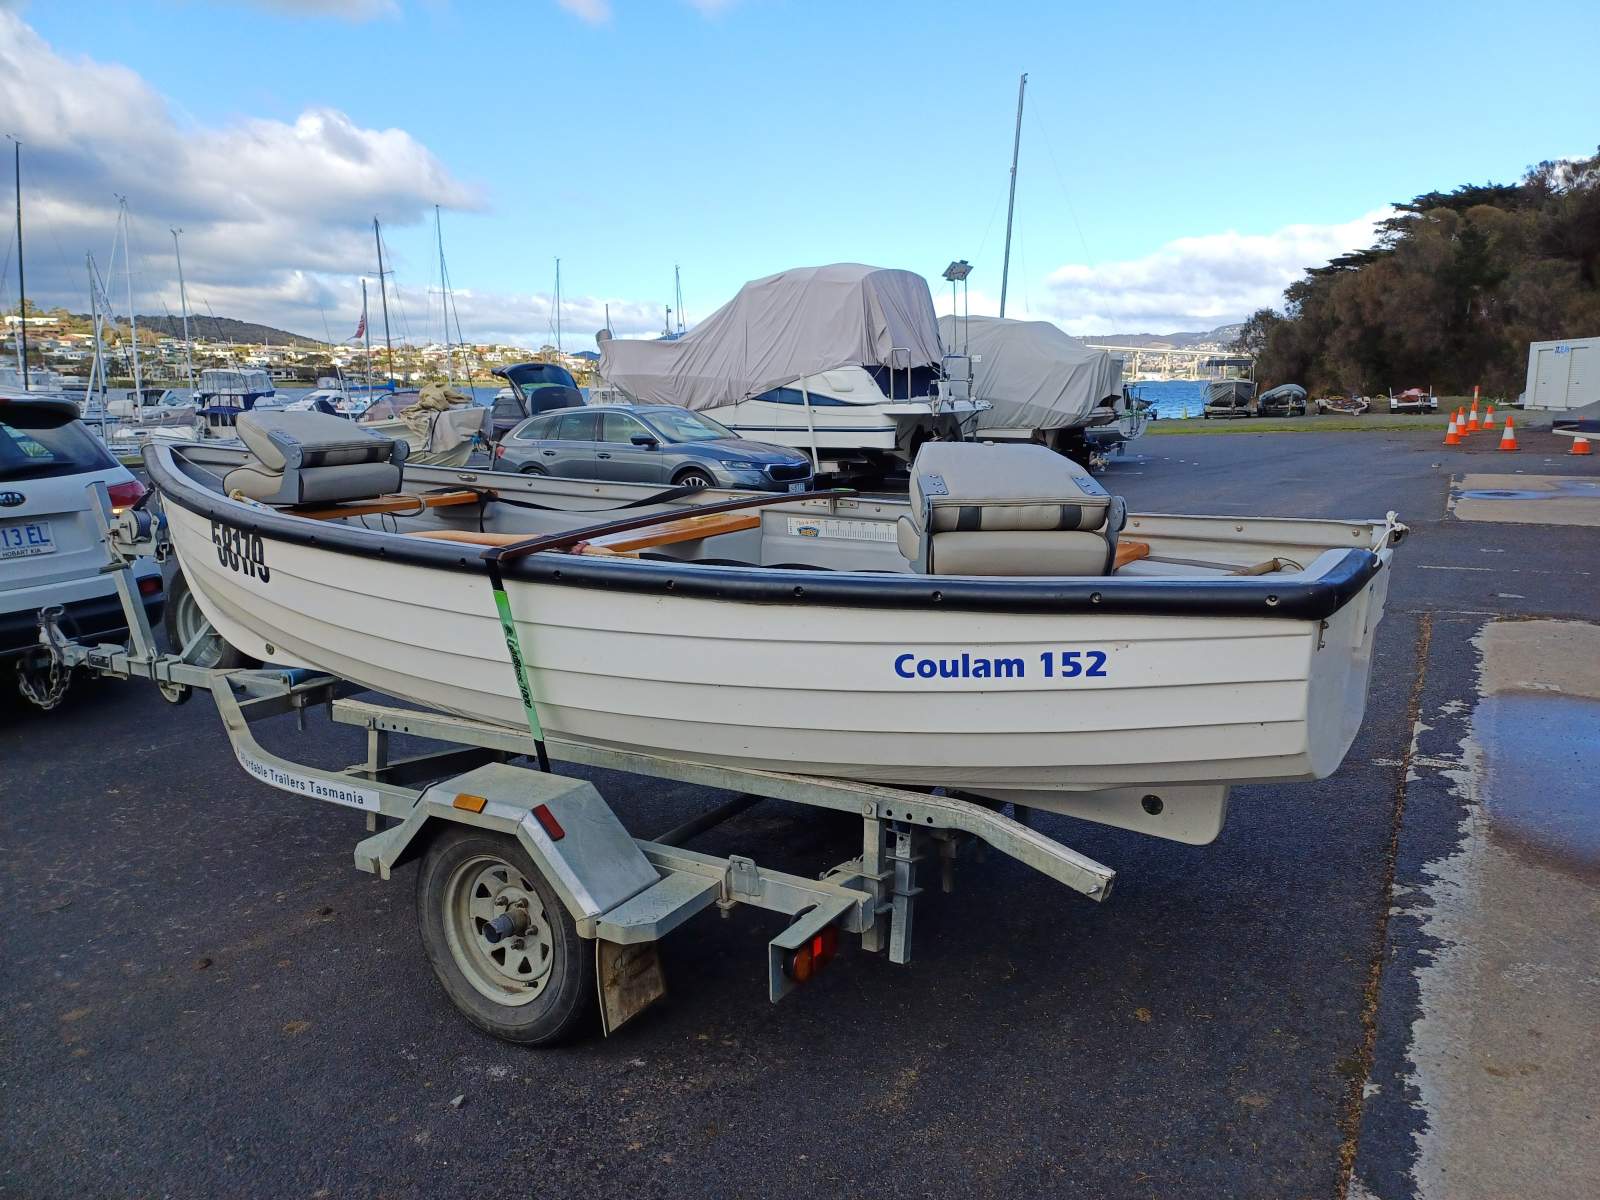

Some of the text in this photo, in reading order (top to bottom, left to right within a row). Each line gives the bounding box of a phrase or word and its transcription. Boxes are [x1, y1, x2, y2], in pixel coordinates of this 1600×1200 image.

[894, 650, 1107, 678] Coulam 152
[240, 751, 364, 804] ordable Trailers Tasmania
